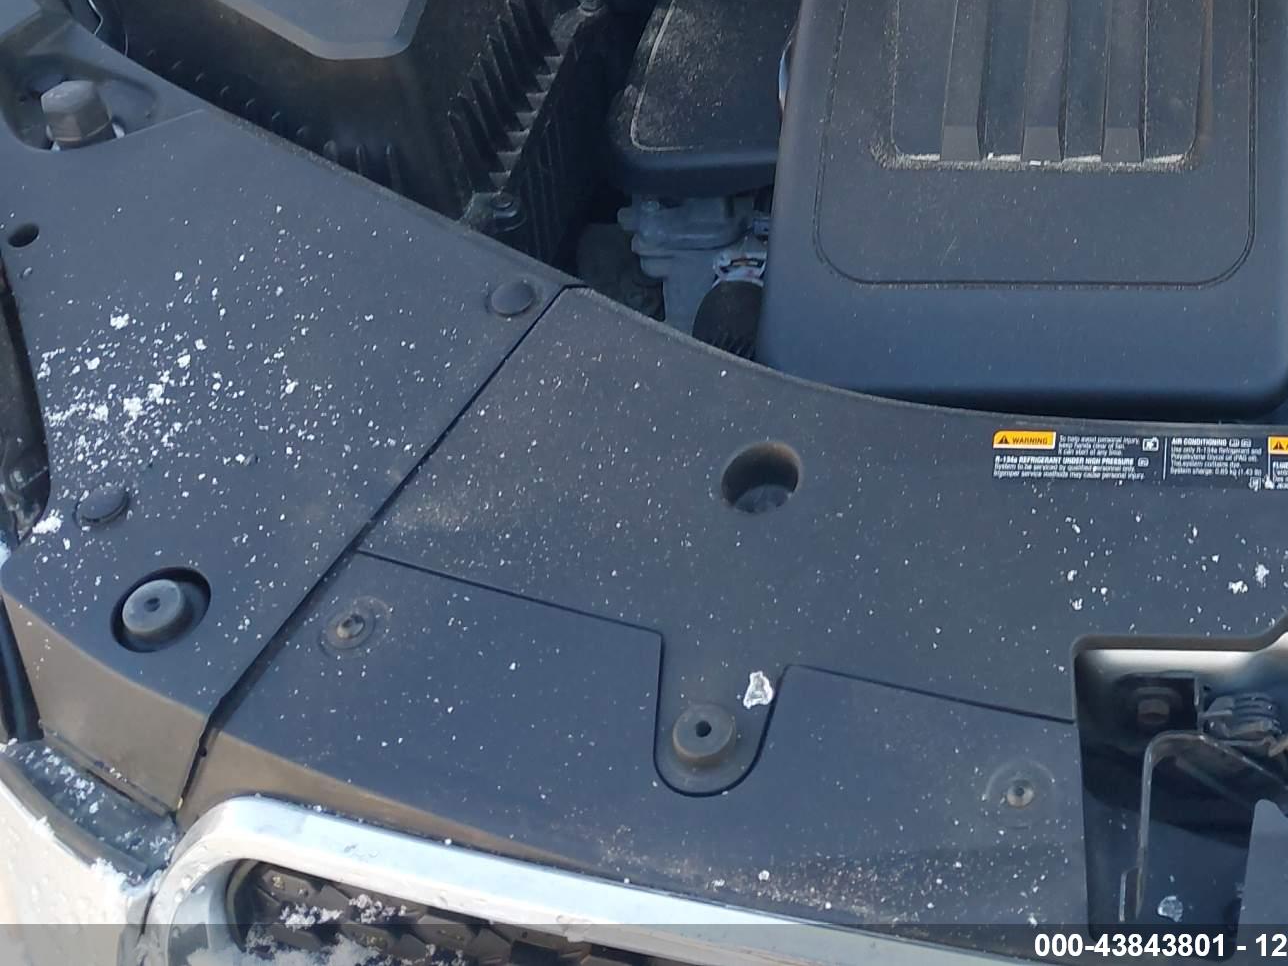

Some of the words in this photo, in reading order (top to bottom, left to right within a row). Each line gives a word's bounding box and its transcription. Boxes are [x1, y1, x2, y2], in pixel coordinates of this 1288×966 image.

[1012, 437, 1048, 445] WARNING
[1097, 436, 1122, 444] personal
[1171, 437, 1183, 445] AIR
[1183, 438, 1227, 446] CONDITIONING
[995, 456, 1018, 464] R-134a
[1018, 456, 1062, 464] REFRIGERANT
[1062, 457, 1084, 465] UNDER
[1085, 457, 1101, 465] HIGH
[995, 464, 1016, 472] System
[1067, 465, 1092, 473] qualified
